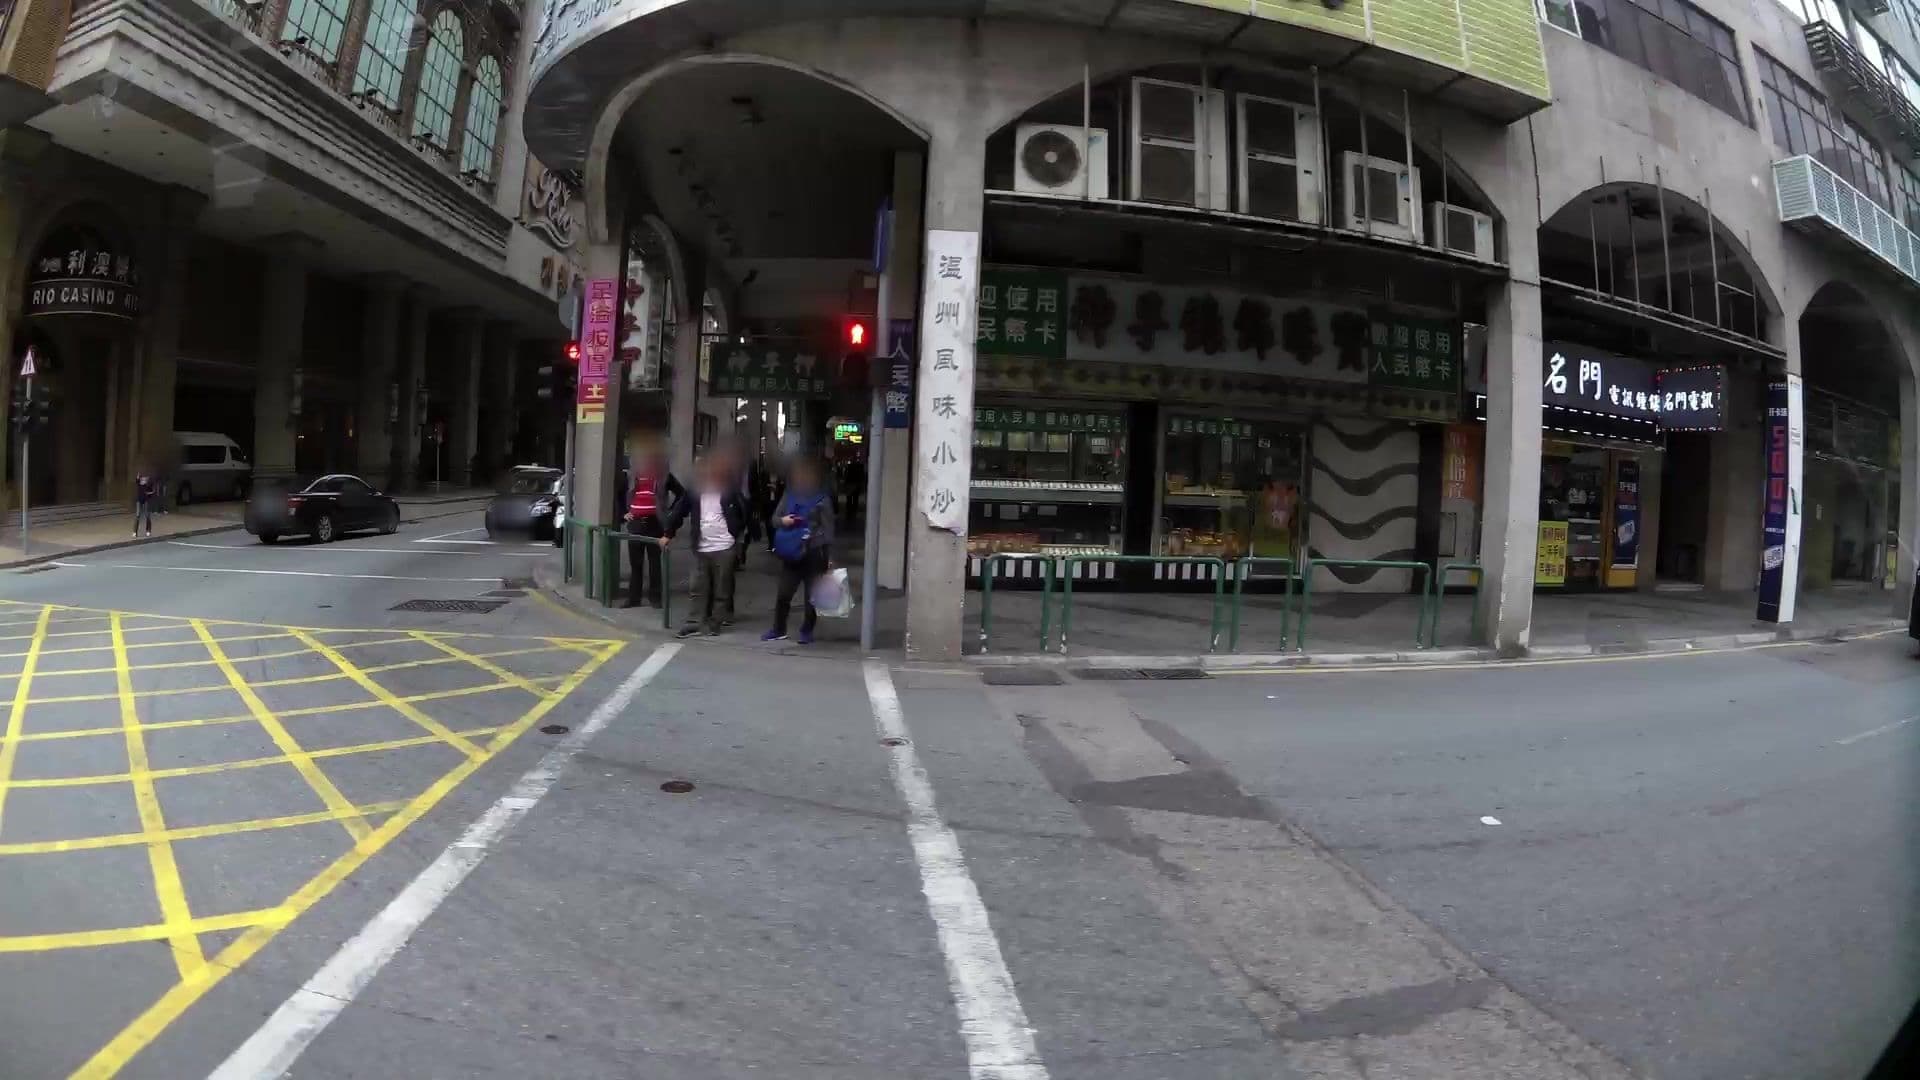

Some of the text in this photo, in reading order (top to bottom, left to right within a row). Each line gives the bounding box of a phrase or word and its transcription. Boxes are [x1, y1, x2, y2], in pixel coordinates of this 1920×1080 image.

[32, 287, 56, 305] RIO
[60, 286, 115, 305] CASINO
[886, 336, 910, 413] 人民幣
[1544, 352, 1602, 401] 名門
[1663, 390, 1714, 412] 名門電訊
